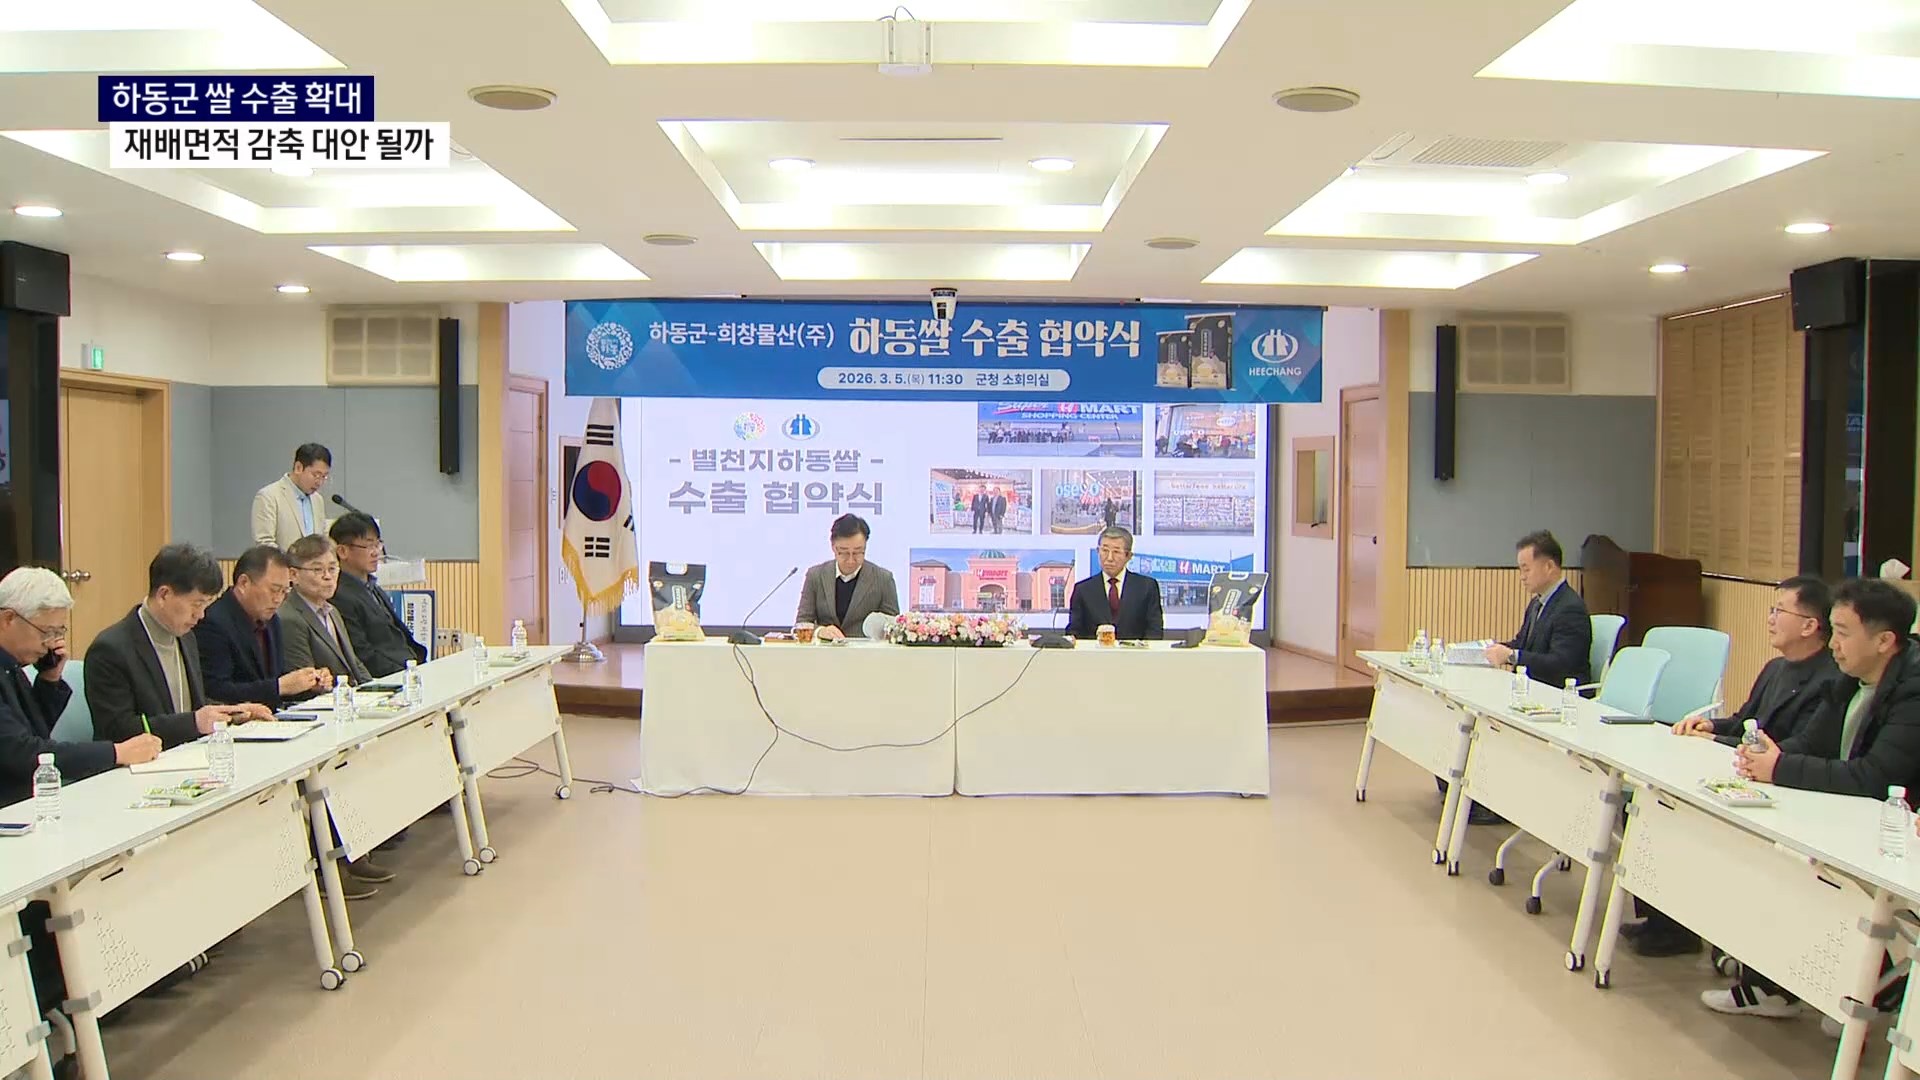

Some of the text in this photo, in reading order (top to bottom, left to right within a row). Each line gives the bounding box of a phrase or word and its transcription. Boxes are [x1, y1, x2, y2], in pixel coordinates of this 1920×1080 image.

[649, 320, 835, 348] 하동군-희창물산(주)
[848, 317, 954, 357] 하동쌀
[961, 318, 1030, 358] 수출
[1038, 318, 1142, 359] 협약식
[1248, 366, 1302, 376] HEECHANG
[838, 372, 877, 385] 2026.
[879, 373, 892, 385] 3.
[928, 373, 963, 386] 11:30
[975, 373, 1000, 387] 군청
[1002, 373, 1050, 388] 소회의실
[1080, 402, 1140, 414] MART
[1021, 411, 1119, 420] SHOPPING CENTER
[691, 448, 861, 472] 별천지하동쌀
[668, 480, 883, 516] 수출 협약식
[1192, 562, 1226, 574] MART
